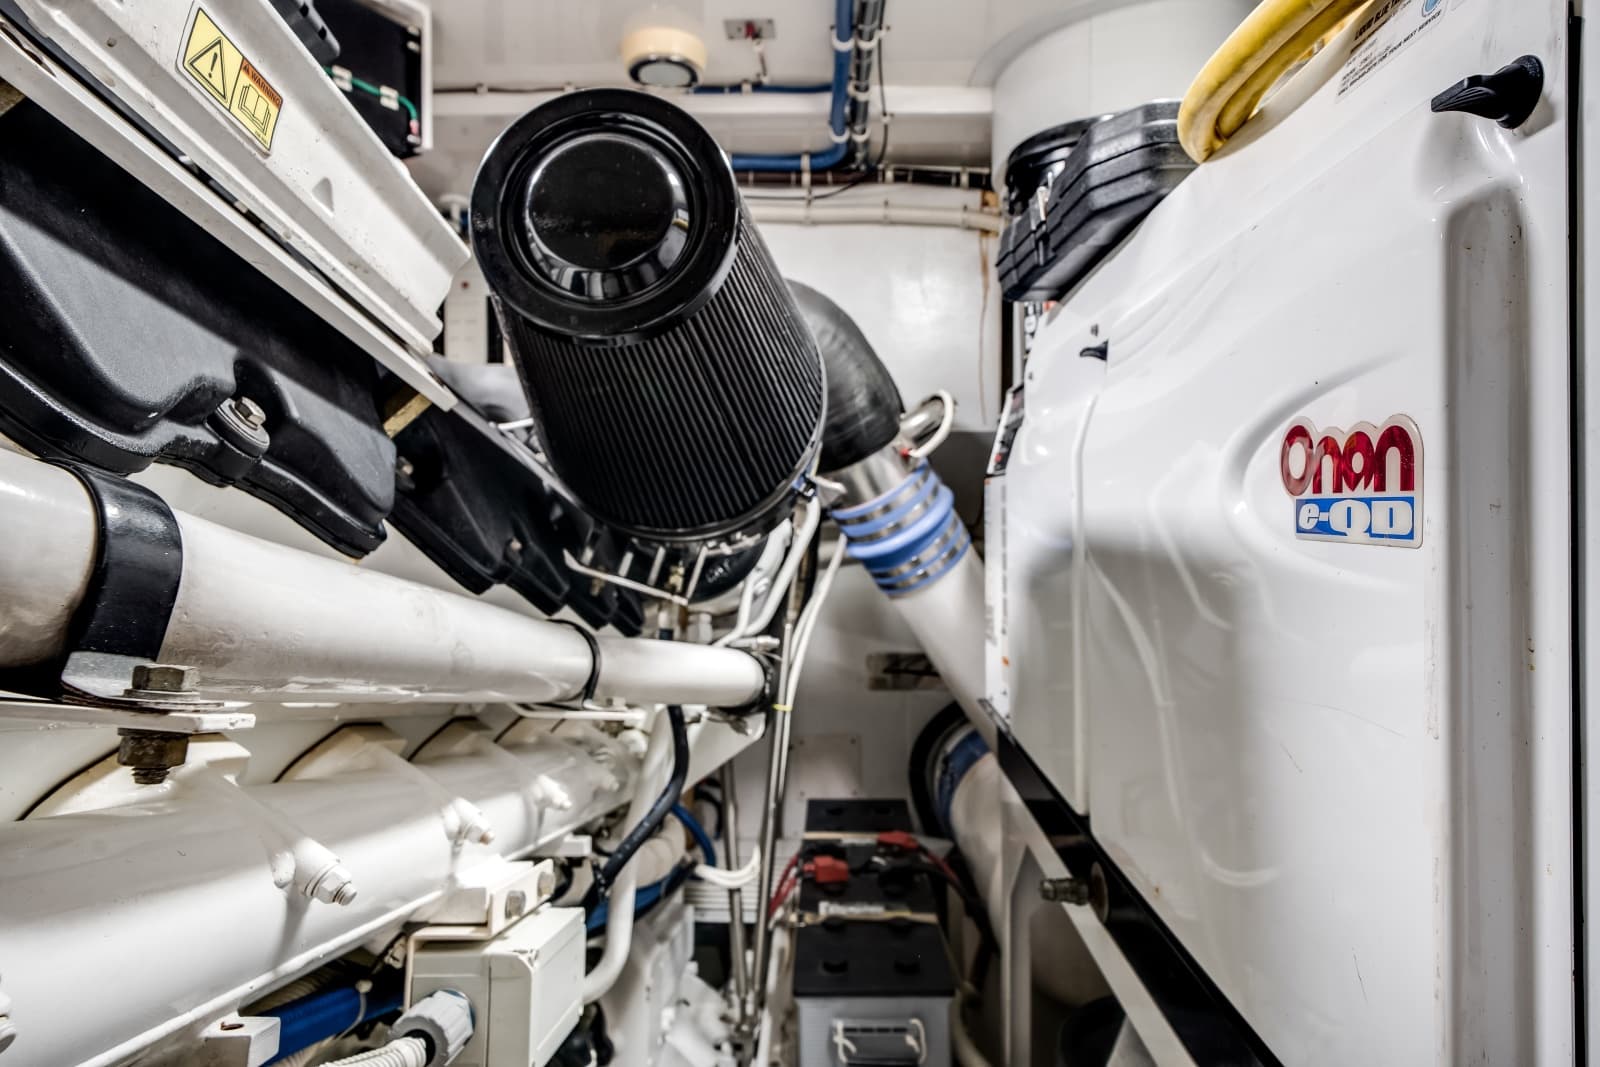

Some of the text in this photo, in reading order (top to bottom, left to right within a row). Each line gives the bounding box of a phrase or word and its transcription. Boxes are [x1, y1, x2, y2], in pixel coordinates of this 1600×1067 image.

[1403, 29, 1418, 44] NEXT
[1418, 9, 1442, 32] SERVICE
[251, 72, 281, 106] WARNING
